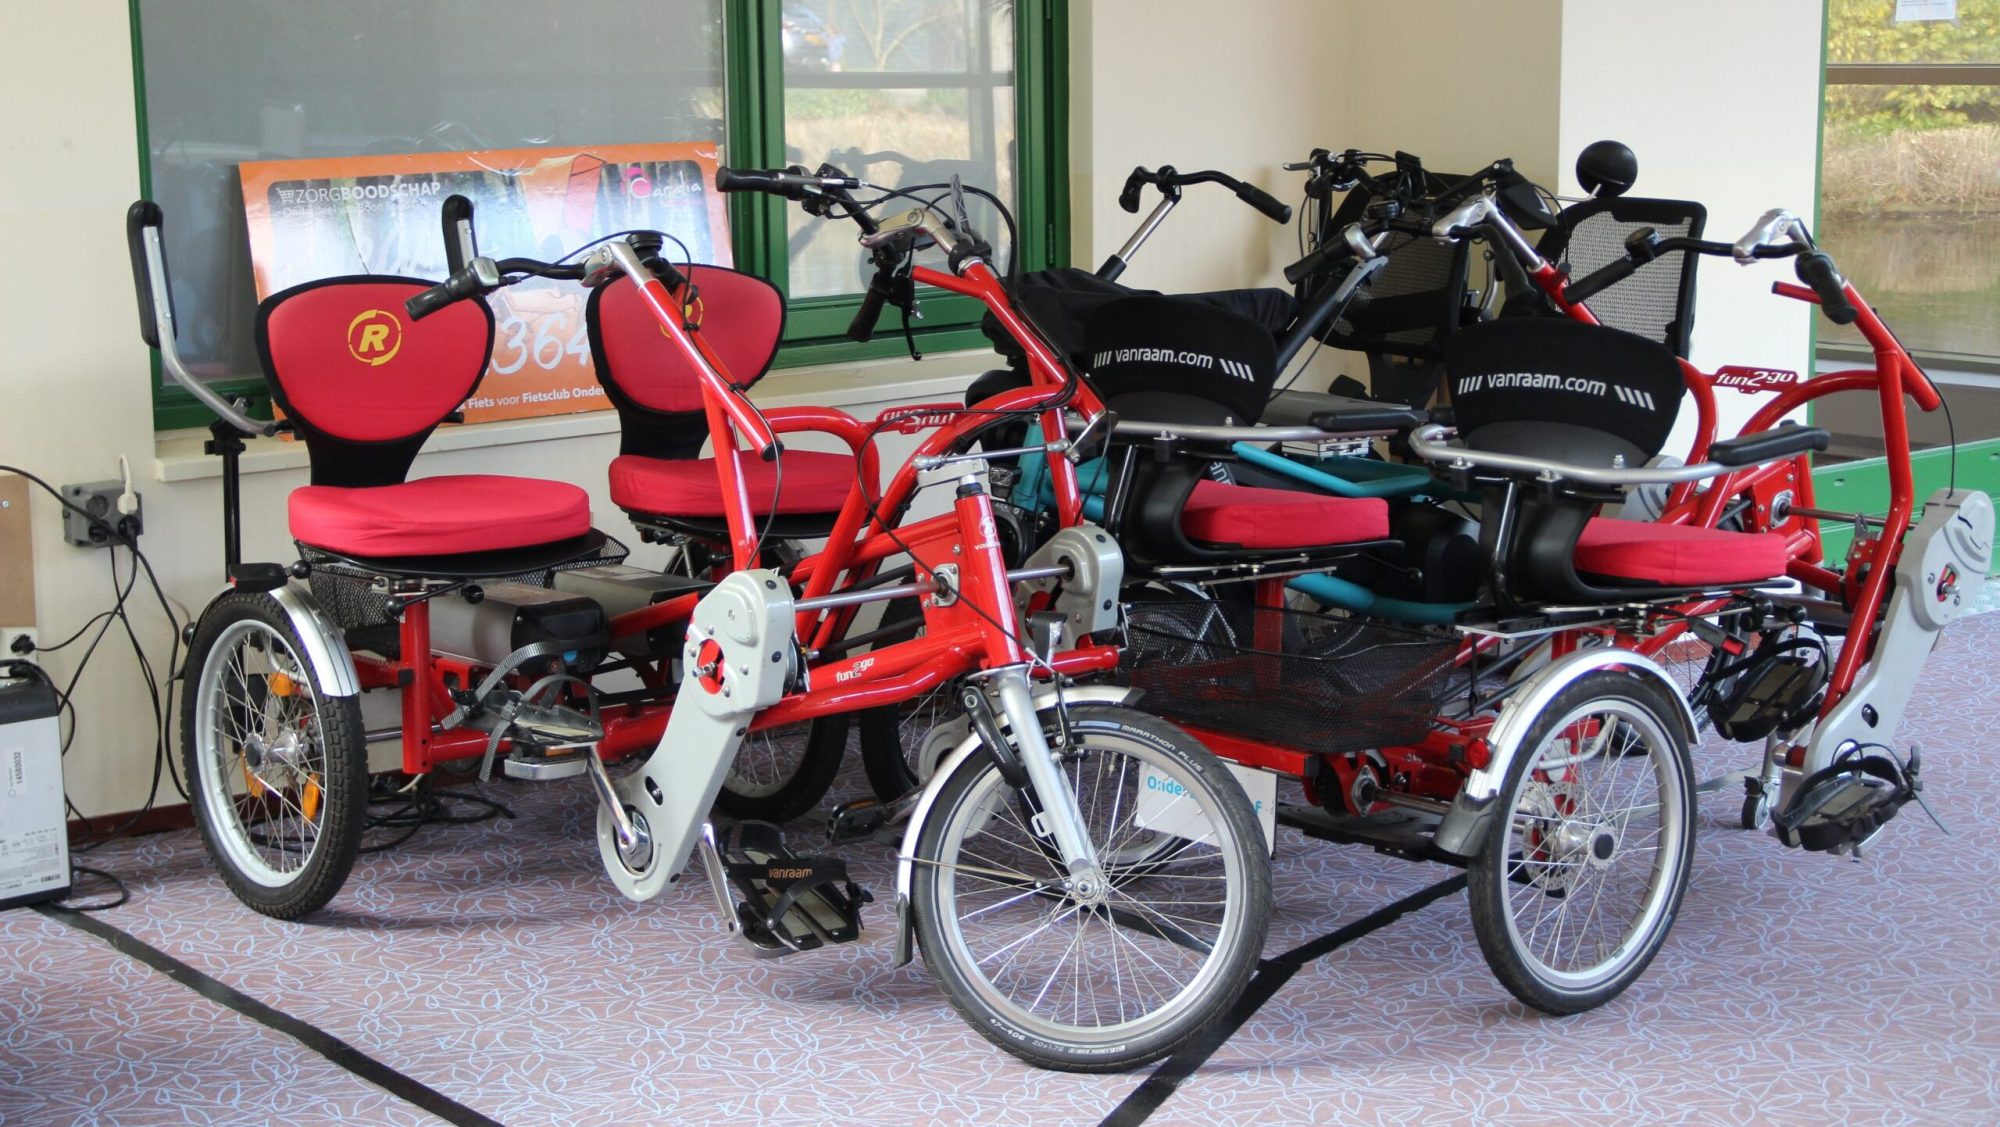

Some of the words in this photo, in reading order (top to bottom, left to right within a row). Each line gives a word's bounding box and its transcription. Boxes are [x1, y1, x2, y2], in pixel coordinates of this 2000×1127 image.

[295, 182, 441, 203] ZORGBOODSCHAP
[485, 312, 590, 376] 364
[1115, 347, 1213, 369] vanraam.com
[1487, 372, 1607, 396] vanraam.com
[1716, 371, 1794, 386] fun2go
[468, 397, 495, 409] Fiets
[497, 396, 520, 406] voor
[522, 388, 571, 403] Fietsclub
[836, 657, 874, 683] fun2go
[1121, 724, 1176, 750] MARATHON
[1178, 751, 1203, 771] PLUS
[1147, 775, 1185, 796] Onde
[768, 868, 813, 879] vanraam
